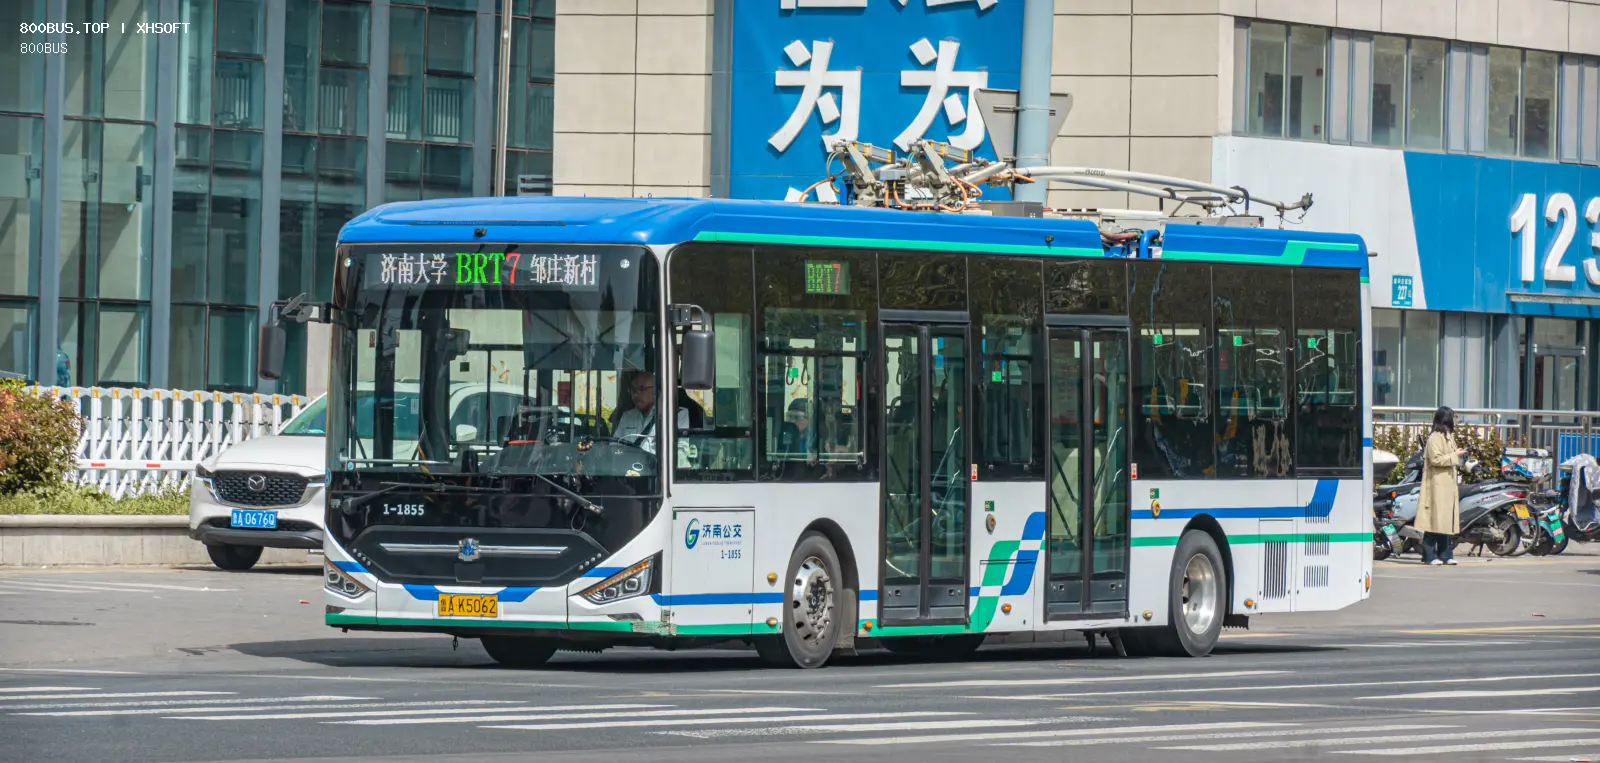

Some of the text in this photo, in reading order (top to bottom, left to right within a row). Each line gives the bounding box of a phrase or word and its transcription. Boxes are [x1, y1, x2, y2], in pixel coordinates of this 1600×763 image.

[380, 252, 597, 285] 济南大学 BRT7 邹庄新村
[807, 263, 841, 293] BRT7
[383, 503, 425, 516] 1-1855
[702, 523, 742, 539] 济南公交
[721, 549, 742, 560] 1-1855
